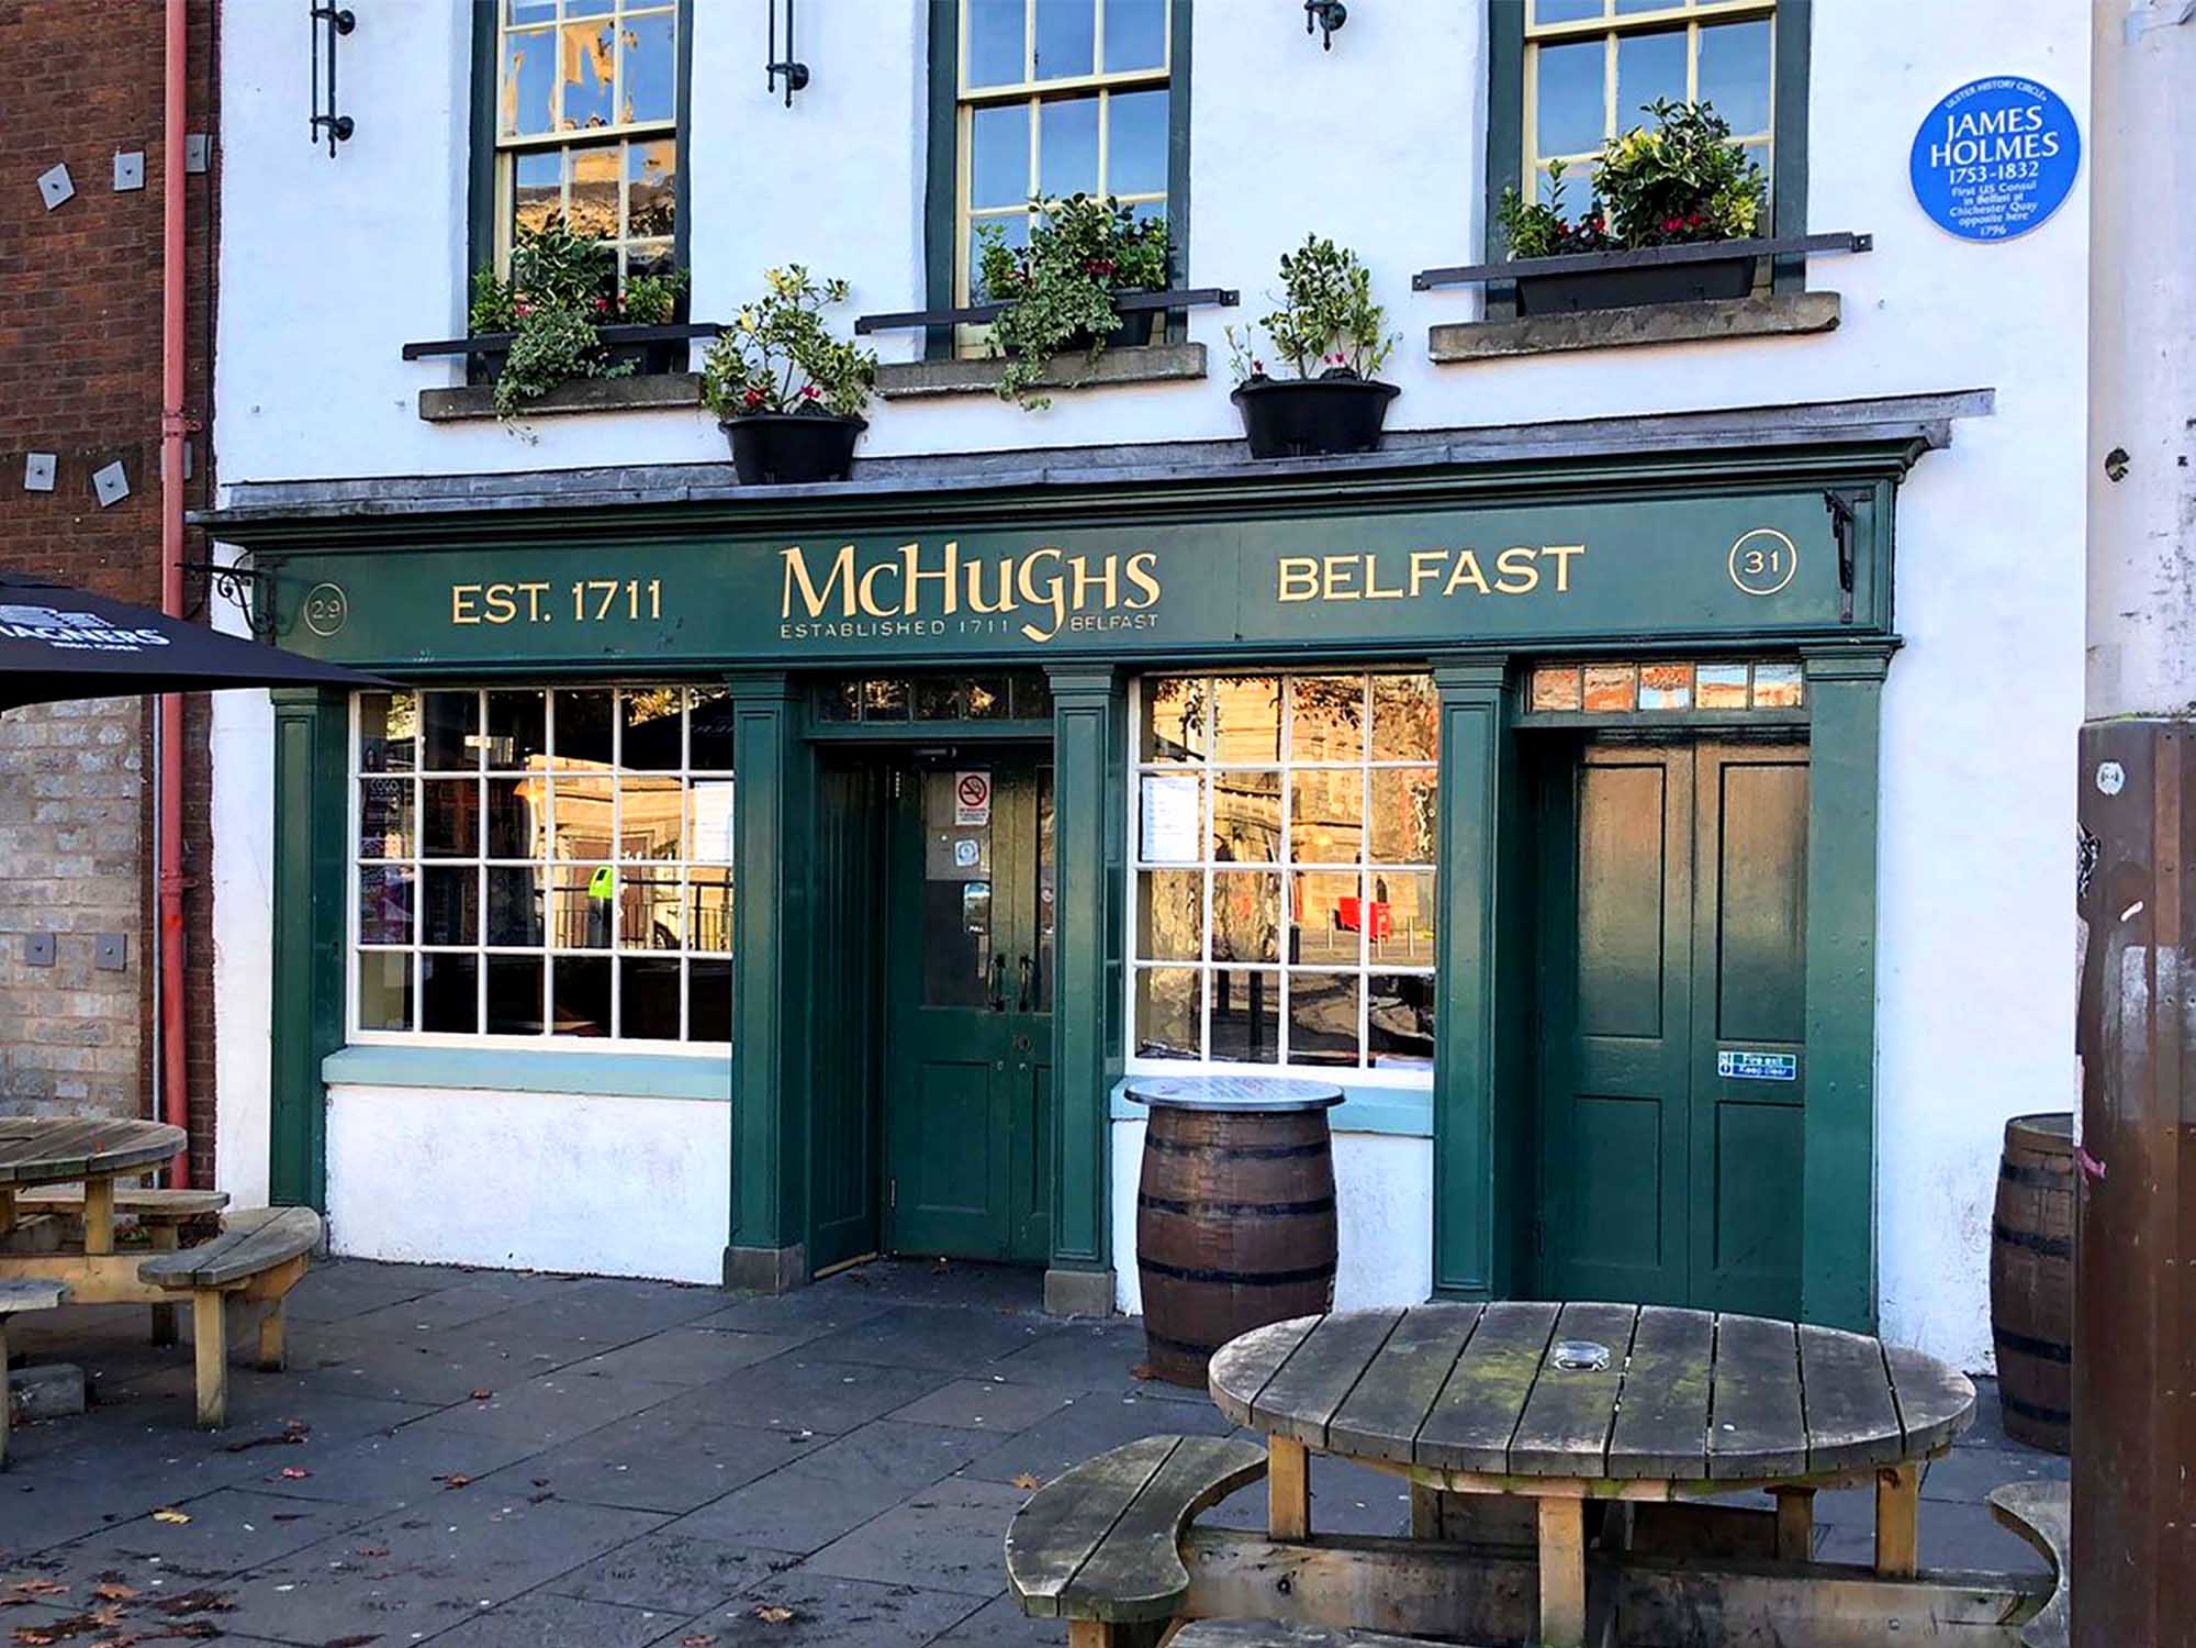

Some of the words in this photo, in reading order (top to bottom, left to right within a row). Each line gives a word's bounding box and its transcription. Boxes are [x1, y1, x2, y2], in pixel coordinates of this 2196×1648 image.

[1945, 86, 1977, 109] ULSTER
[1978, 79, 2016, 92] HISTORY
[1948, 105, 2042, 142] JAMES
[1931, 131, 2059, 168] HOLMES
[1951, 186, 1975, 198] First
[1979, 183, 1996, 195] US
[1998, 180, 2037, 193] Consul
[1963, 197, 1974, 206] in
[1976, 193, 2011, 206] Belfast
[1949, 203, 2006, 218] Chichester
[2009, 201, 2038, 214] Quay
[1958, 214, 2003, 229] opposite
[2005, 212, 2029, 222] here
[1981, 224, 2007, 237] 1796
[1277, 544, 1585, 602] BELFAST
[1744, 550, 1779, 574] 31
[312, 600, 341, 620] 29
[452, 583, 552, 625] EST.
[572, 579, 661, 621] 1711
[780, 620, 946, 640] ESTABLISHED
[958, 619, 1009, 634] 1711
[1070, 613, 1159, 632] BELFAST
